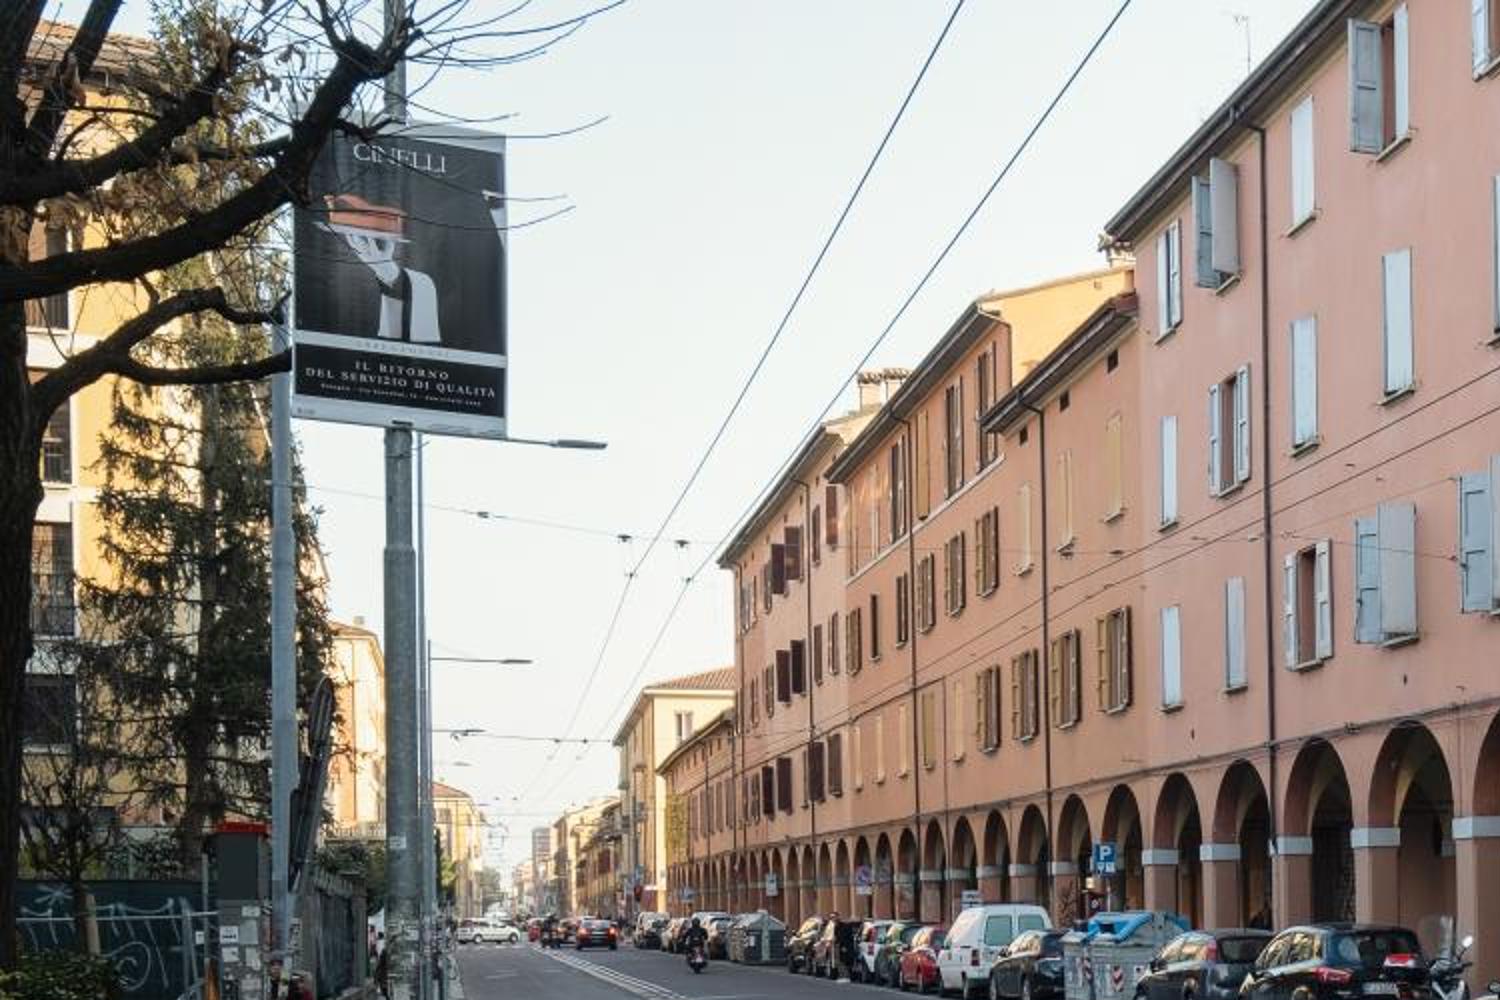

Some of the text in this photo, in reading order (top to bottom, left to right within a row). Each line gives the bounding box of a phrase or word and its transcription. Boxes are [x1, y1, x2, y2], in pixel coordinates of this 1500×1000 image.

[355, 361, 449, 380] IL RITORNO
[305, 367, 334, 379] DEL
[341, 371, 407, 388] SERVIZIO
[414, 380, 430, 391] DI
[436, 383, 496, 399] QUALITÀ
[1100, 846, 1111, 861] P
